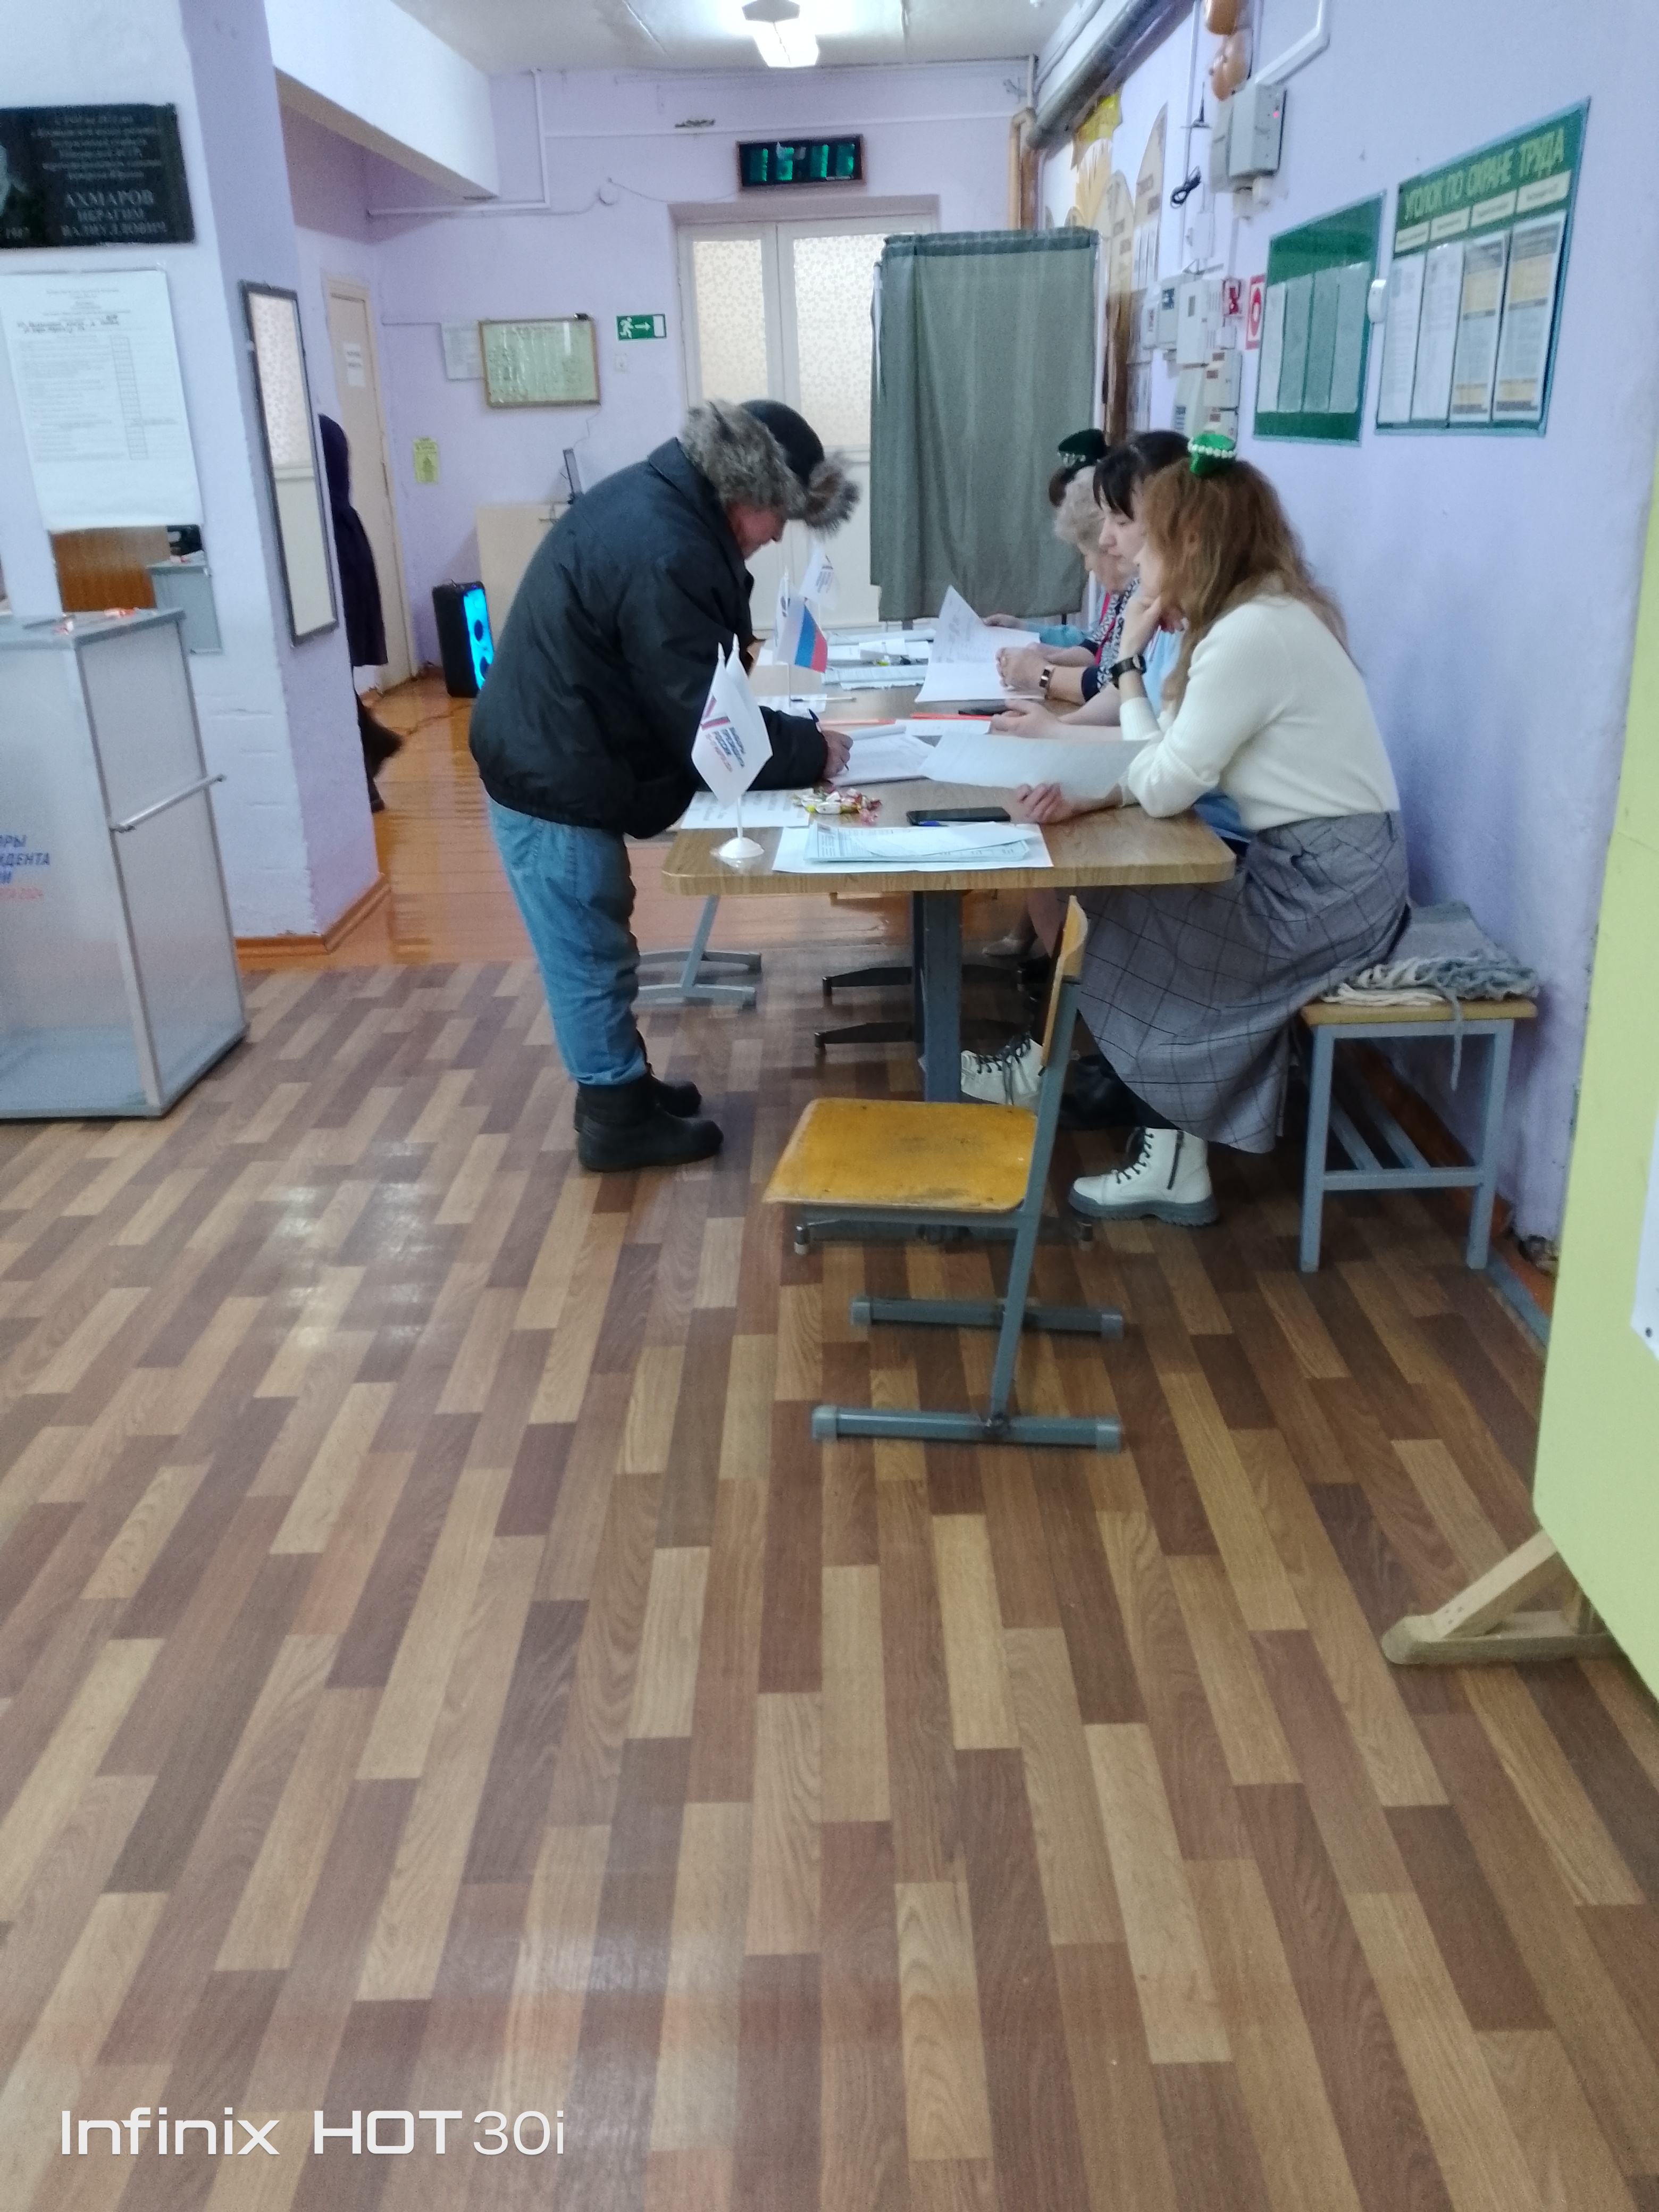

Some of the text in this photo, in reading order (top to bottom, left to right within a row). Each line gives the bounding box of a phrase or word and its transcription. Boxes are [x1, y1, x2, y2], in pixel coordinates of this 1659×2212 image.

[1444, 170, 1464, 208] ПО
[1466, 148, 1514, 197] ОХРАНЕ
[1519, 126, 1564, 179] ТРУДА
